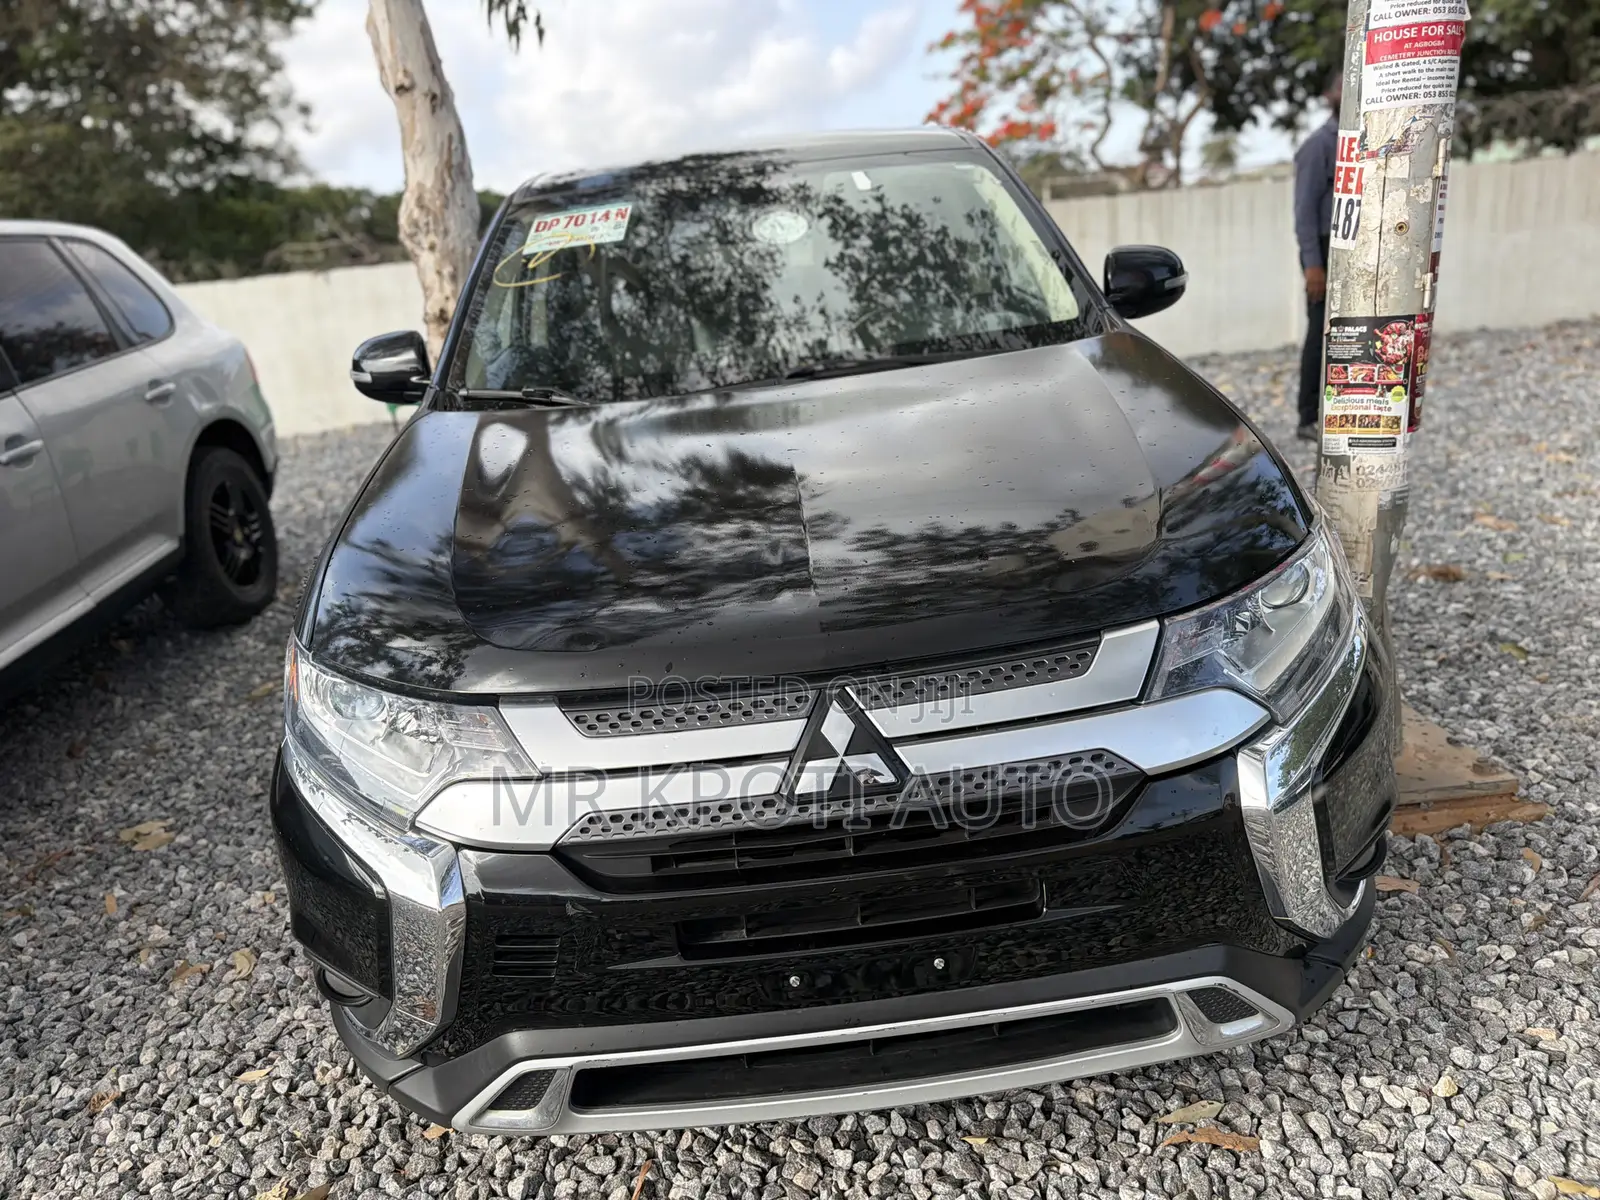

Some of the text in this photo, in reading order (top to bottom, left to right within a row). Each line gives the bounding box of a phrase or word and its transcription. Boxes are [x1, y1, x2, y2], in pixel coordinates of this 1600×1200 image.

[1407, 0, 1431, 8] reduced
[1373, 12, 1392, 21] CALL
[1394, 7, 1431, 18] OWNER:
[1374, 27, 1418, 43] HOUSE
[1421, 25, 1445, 36] FOR
[1380, 51, 1415, 61] CEMETERY
[1373, 63, 1394, 71] Walled
[1397, 84, 1421, 92] reduced
[1365, 95, 1384, 104] CALL
[1385, 92, 1421, 102] OWNER:
[535, 218, 560, 233] DP
[615, 207, 629, 220] N
[1333, 397, 1365, 405] Delicious
